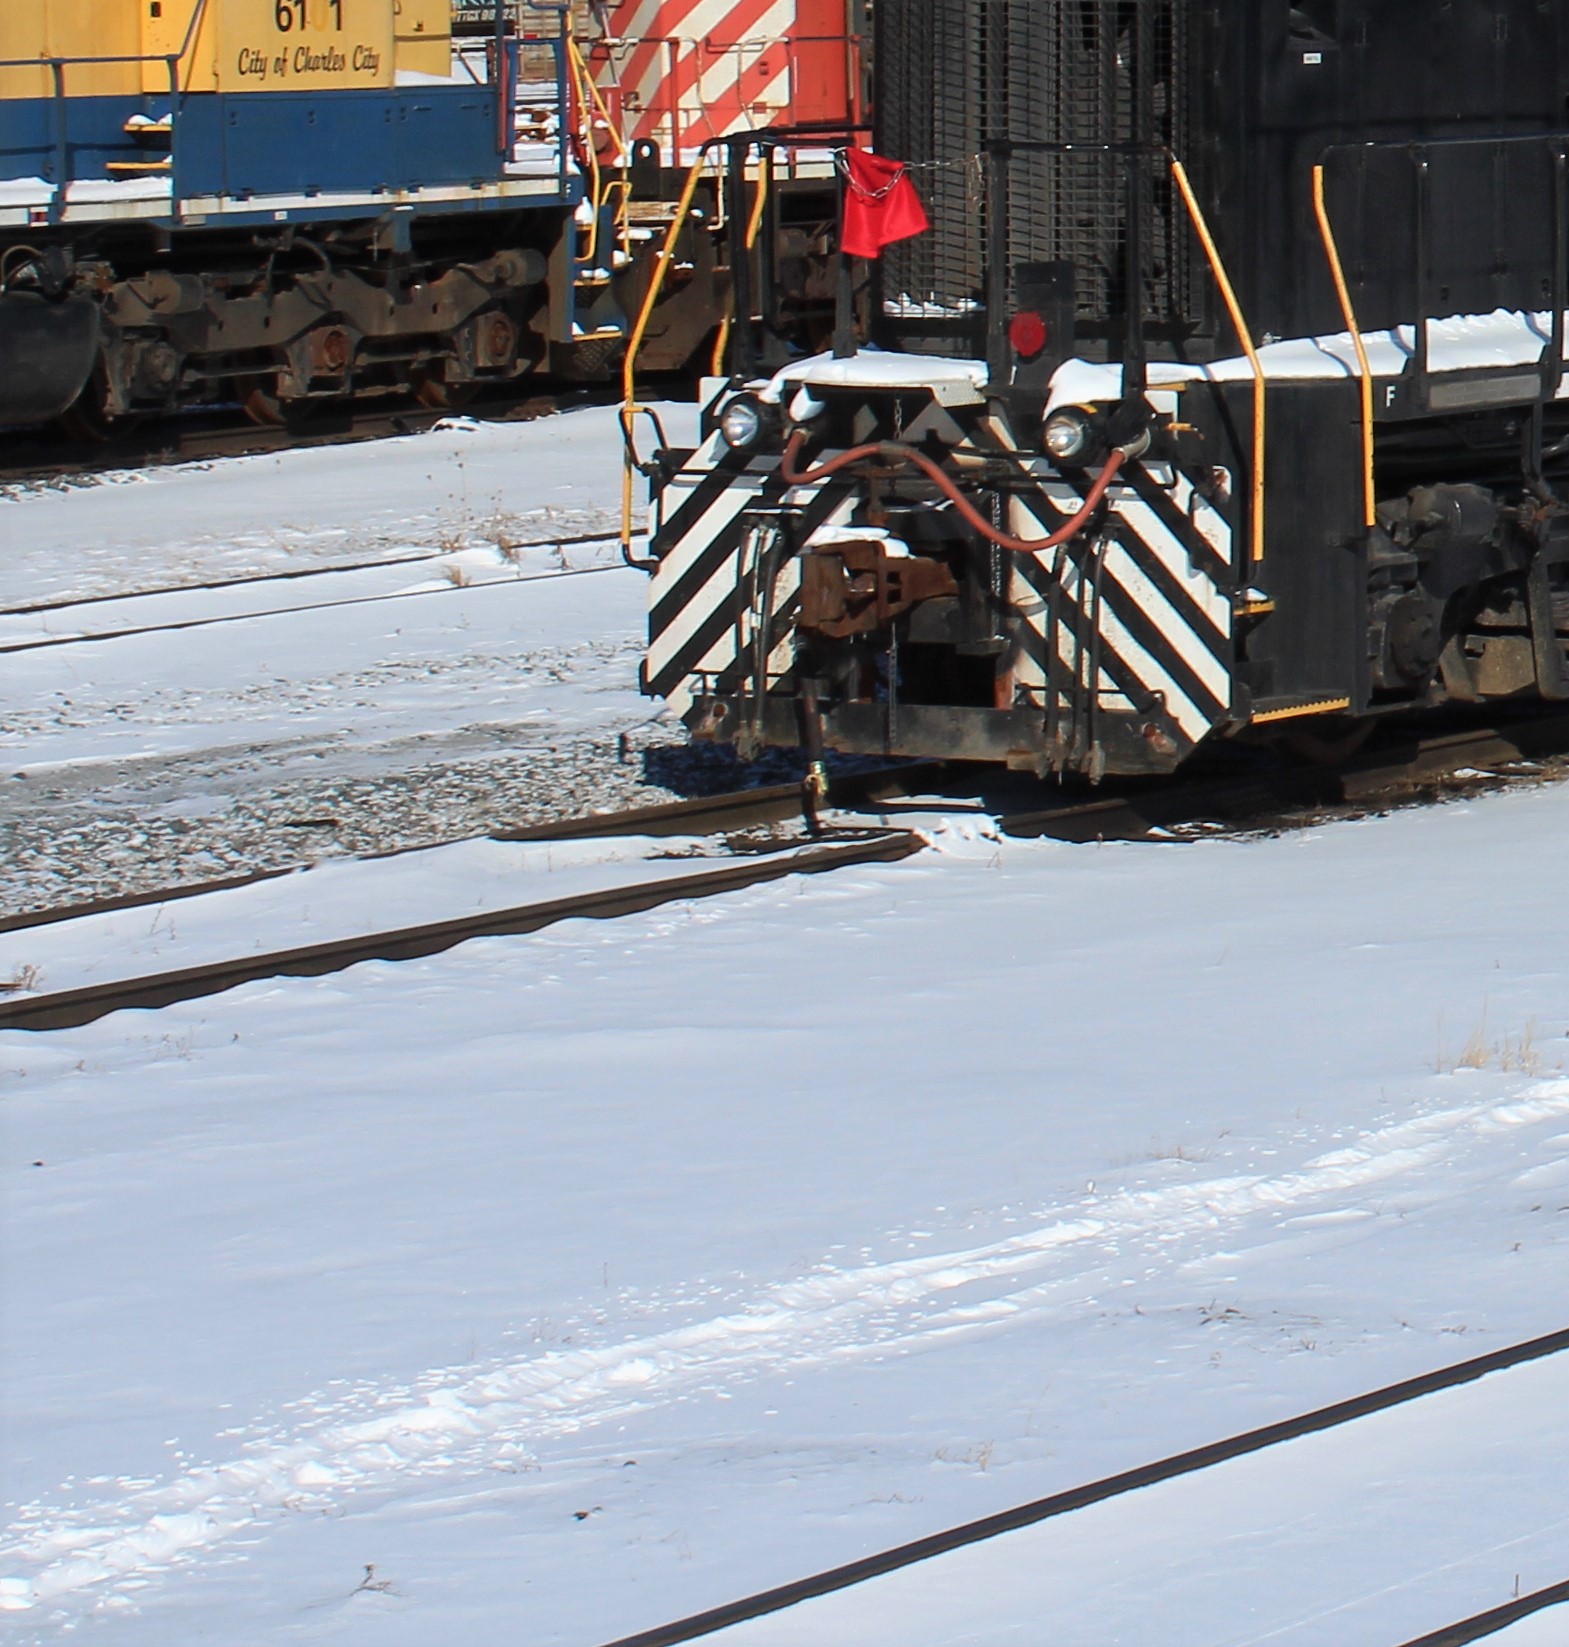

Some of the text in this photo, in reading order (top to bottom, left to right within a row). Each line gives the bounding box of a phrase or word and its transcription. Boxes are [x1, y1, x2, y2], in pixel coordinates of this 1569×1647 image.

[238, 45, 380, 80] City of Charles City
[1386, 385, 1396, 408] F
